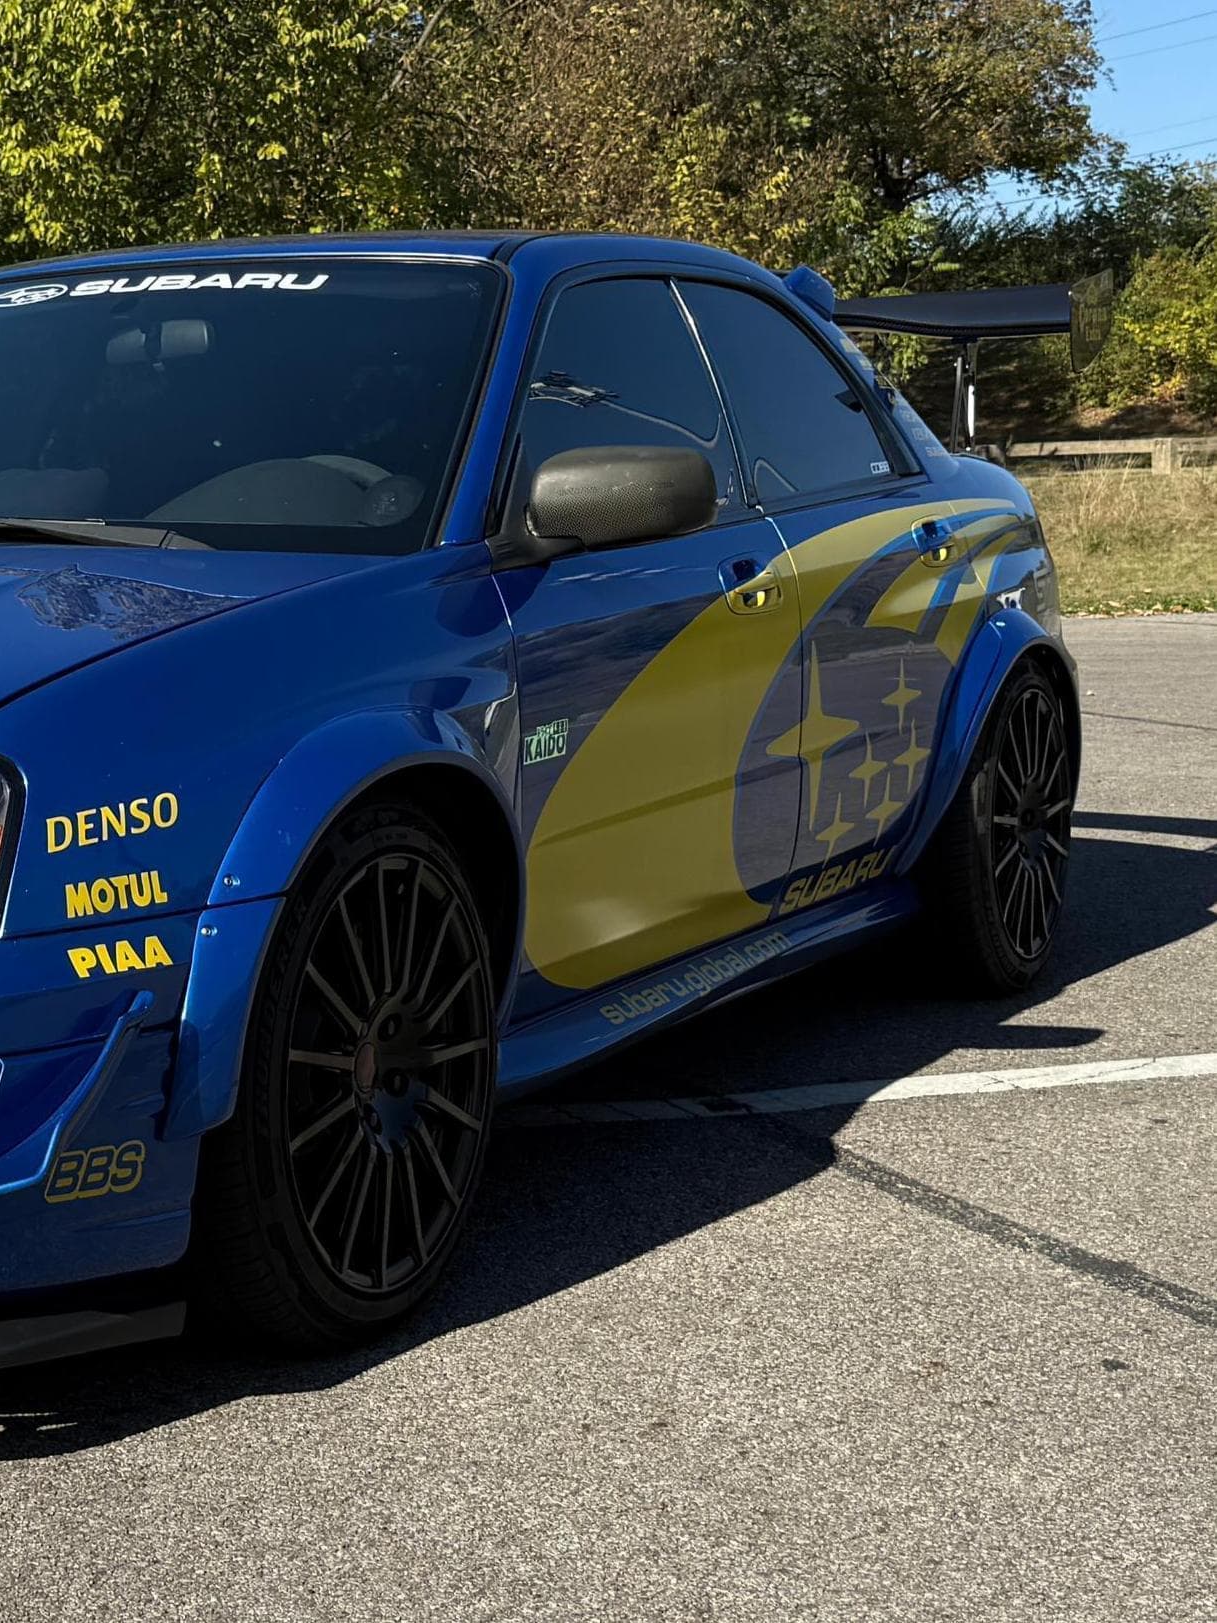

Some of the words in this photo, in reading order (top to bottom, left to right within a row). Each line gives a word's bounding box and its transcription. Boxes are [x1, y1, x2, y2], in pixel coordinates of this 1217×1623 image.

[68, 273, 329, 297] SUBARU
[525, 735, 565, 762] KAIDO
[46, 792, 178, 853] DENSO
[65, 871, 168, 918] MOTUL
[779, 845, 897, 916] SUBARU
[67, 936, 173, 978] PIAA
[44, 1140, 146, 1203] BBS
